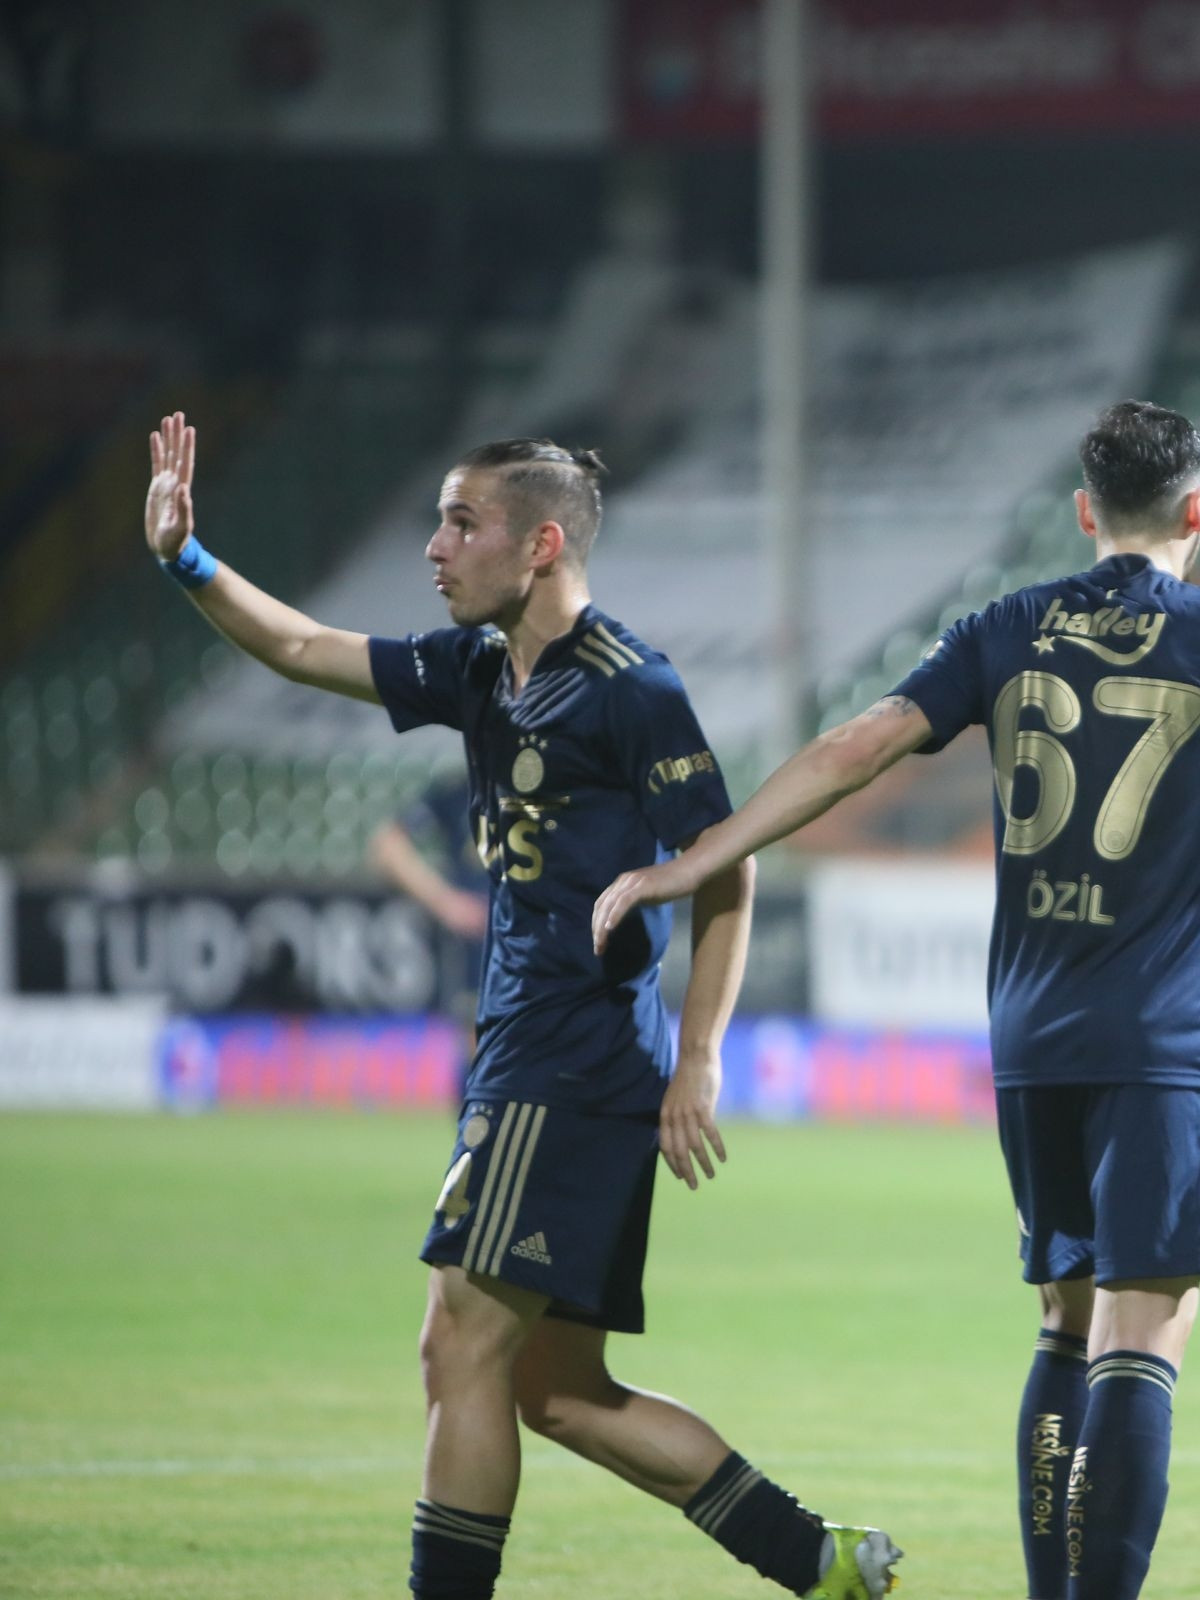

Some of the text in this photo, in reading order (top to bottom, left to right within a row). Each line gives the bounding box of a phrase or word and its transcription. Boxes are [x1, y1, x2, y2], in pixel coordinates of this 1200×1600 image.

[1038, 597, 1167, 666] halley
[1026, 868, 1116, 926] ÖZİL
[510, 1244, 553, 1266] adidas
